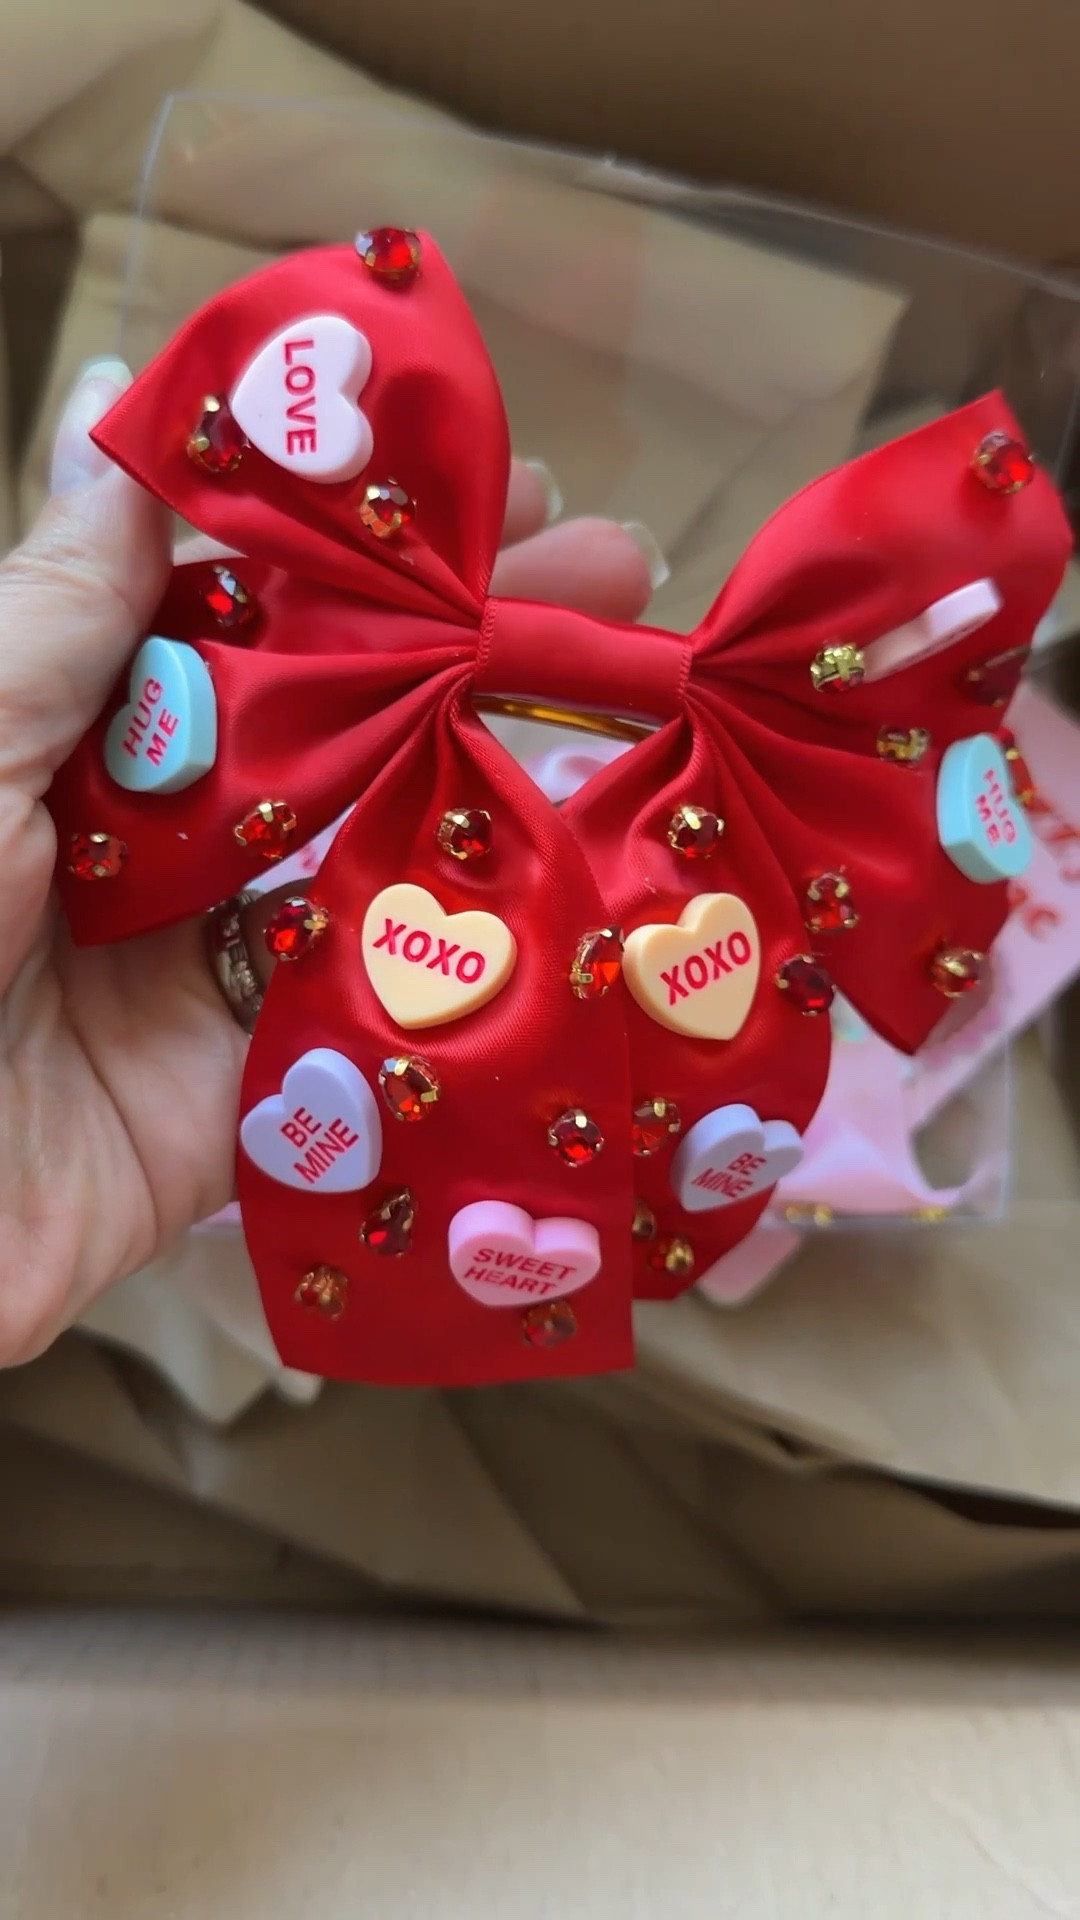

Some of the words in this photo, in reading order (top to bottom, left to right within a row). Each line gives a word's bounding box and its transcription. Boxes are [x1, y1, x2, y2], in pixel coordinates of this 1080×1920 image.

[285, 339, 316, 456] LOVE
[122, 678, 163, 758] HUG
[146, 708, 179, 767] ME
[373, 918, 486, 984] XOXO
[659, 931, 751, 1005] XOXO
[280, 1107, 322, 1148] BE
[293, 1118, 359, 1184] MINE
[691, 1168, 753, 1198] MINE
[727, 1152, 767, 1175] BE
[464, 1266, 557, 1294] HEART
[473, 1248, 577, 1280] SWEET
